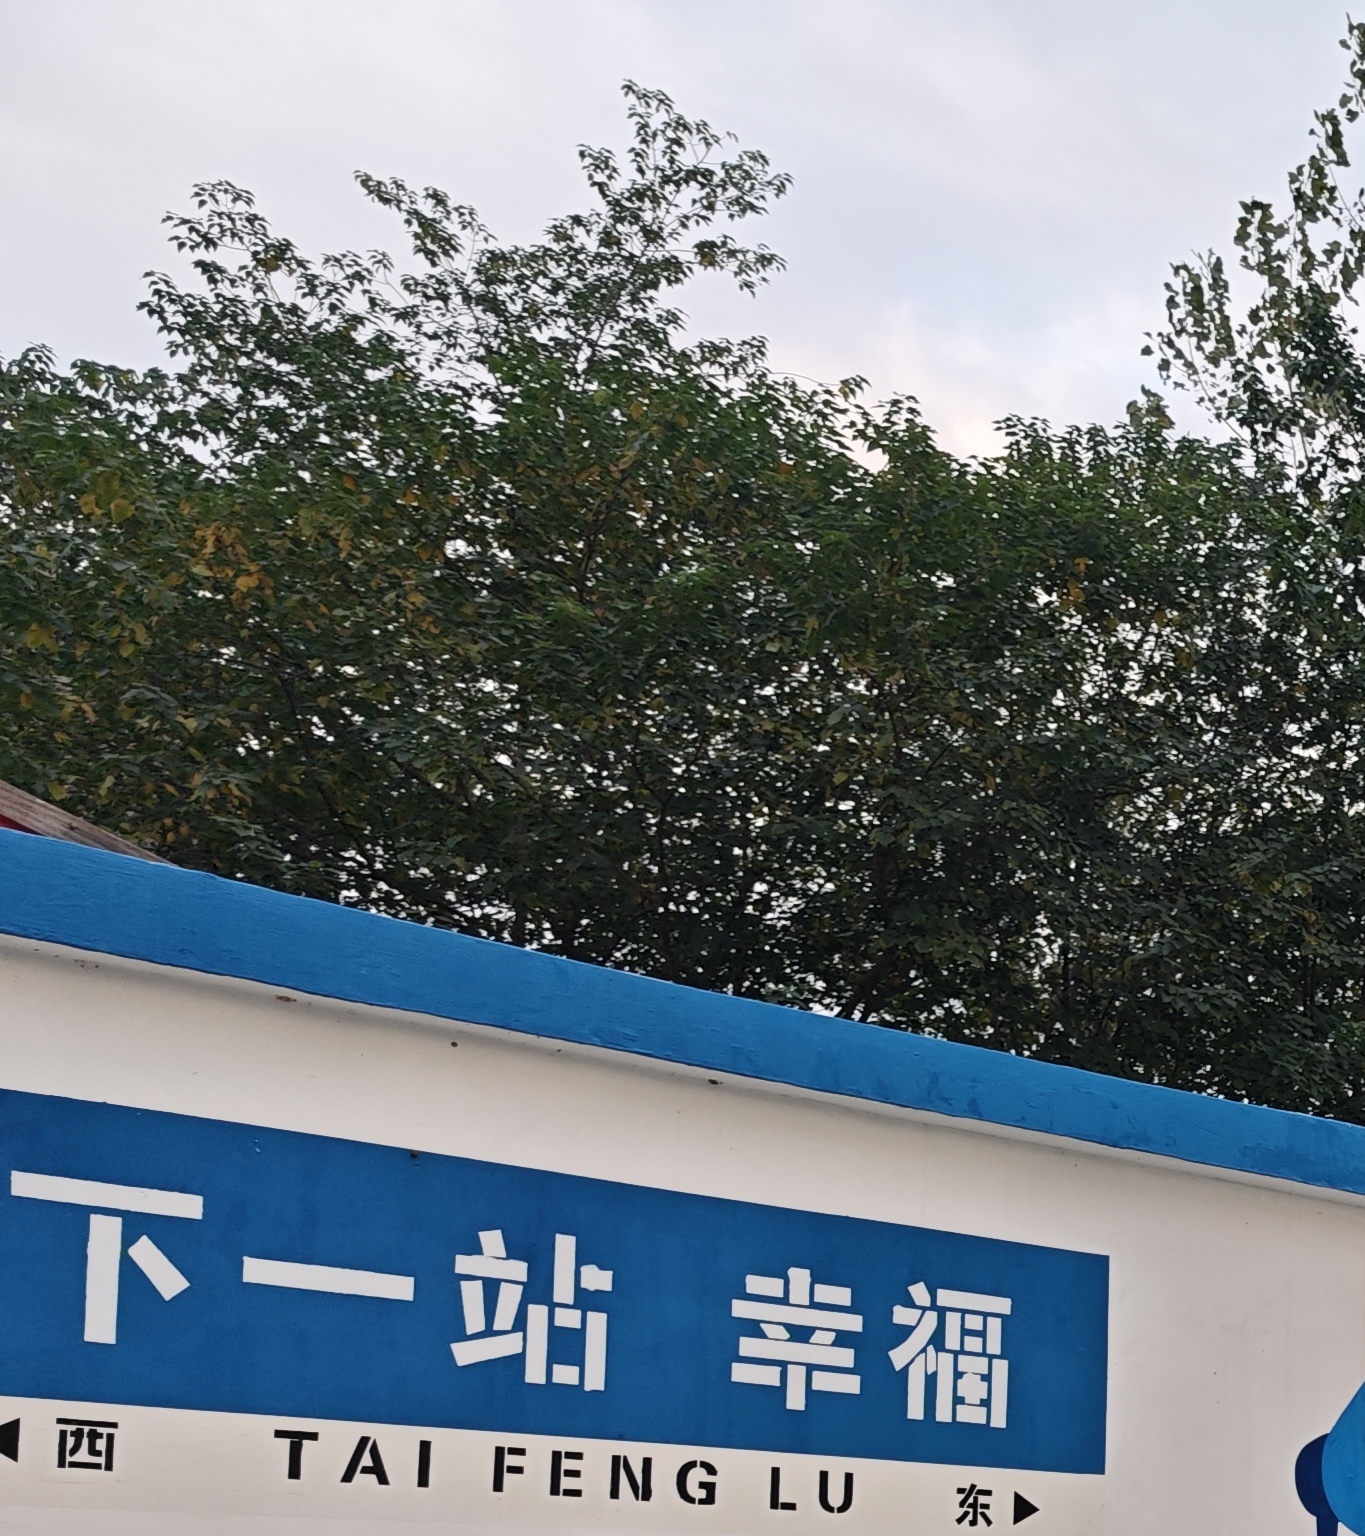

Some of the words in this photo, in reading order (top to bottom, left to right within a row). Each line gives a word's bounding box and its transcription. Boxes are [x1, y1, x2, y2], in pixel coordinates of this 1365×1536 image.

[11, 1169, 614, 1392] 下一站
[731, 1267, 1012, 1429] 幸福
[56, 1417, 119, 1472] 西
[274, 1428, 433, 1488] TAI
[492, 1446, 719, 1506] FENG
[769, 1466, 856, 1514] LU
[955, 1483, 993, 1528] 东
